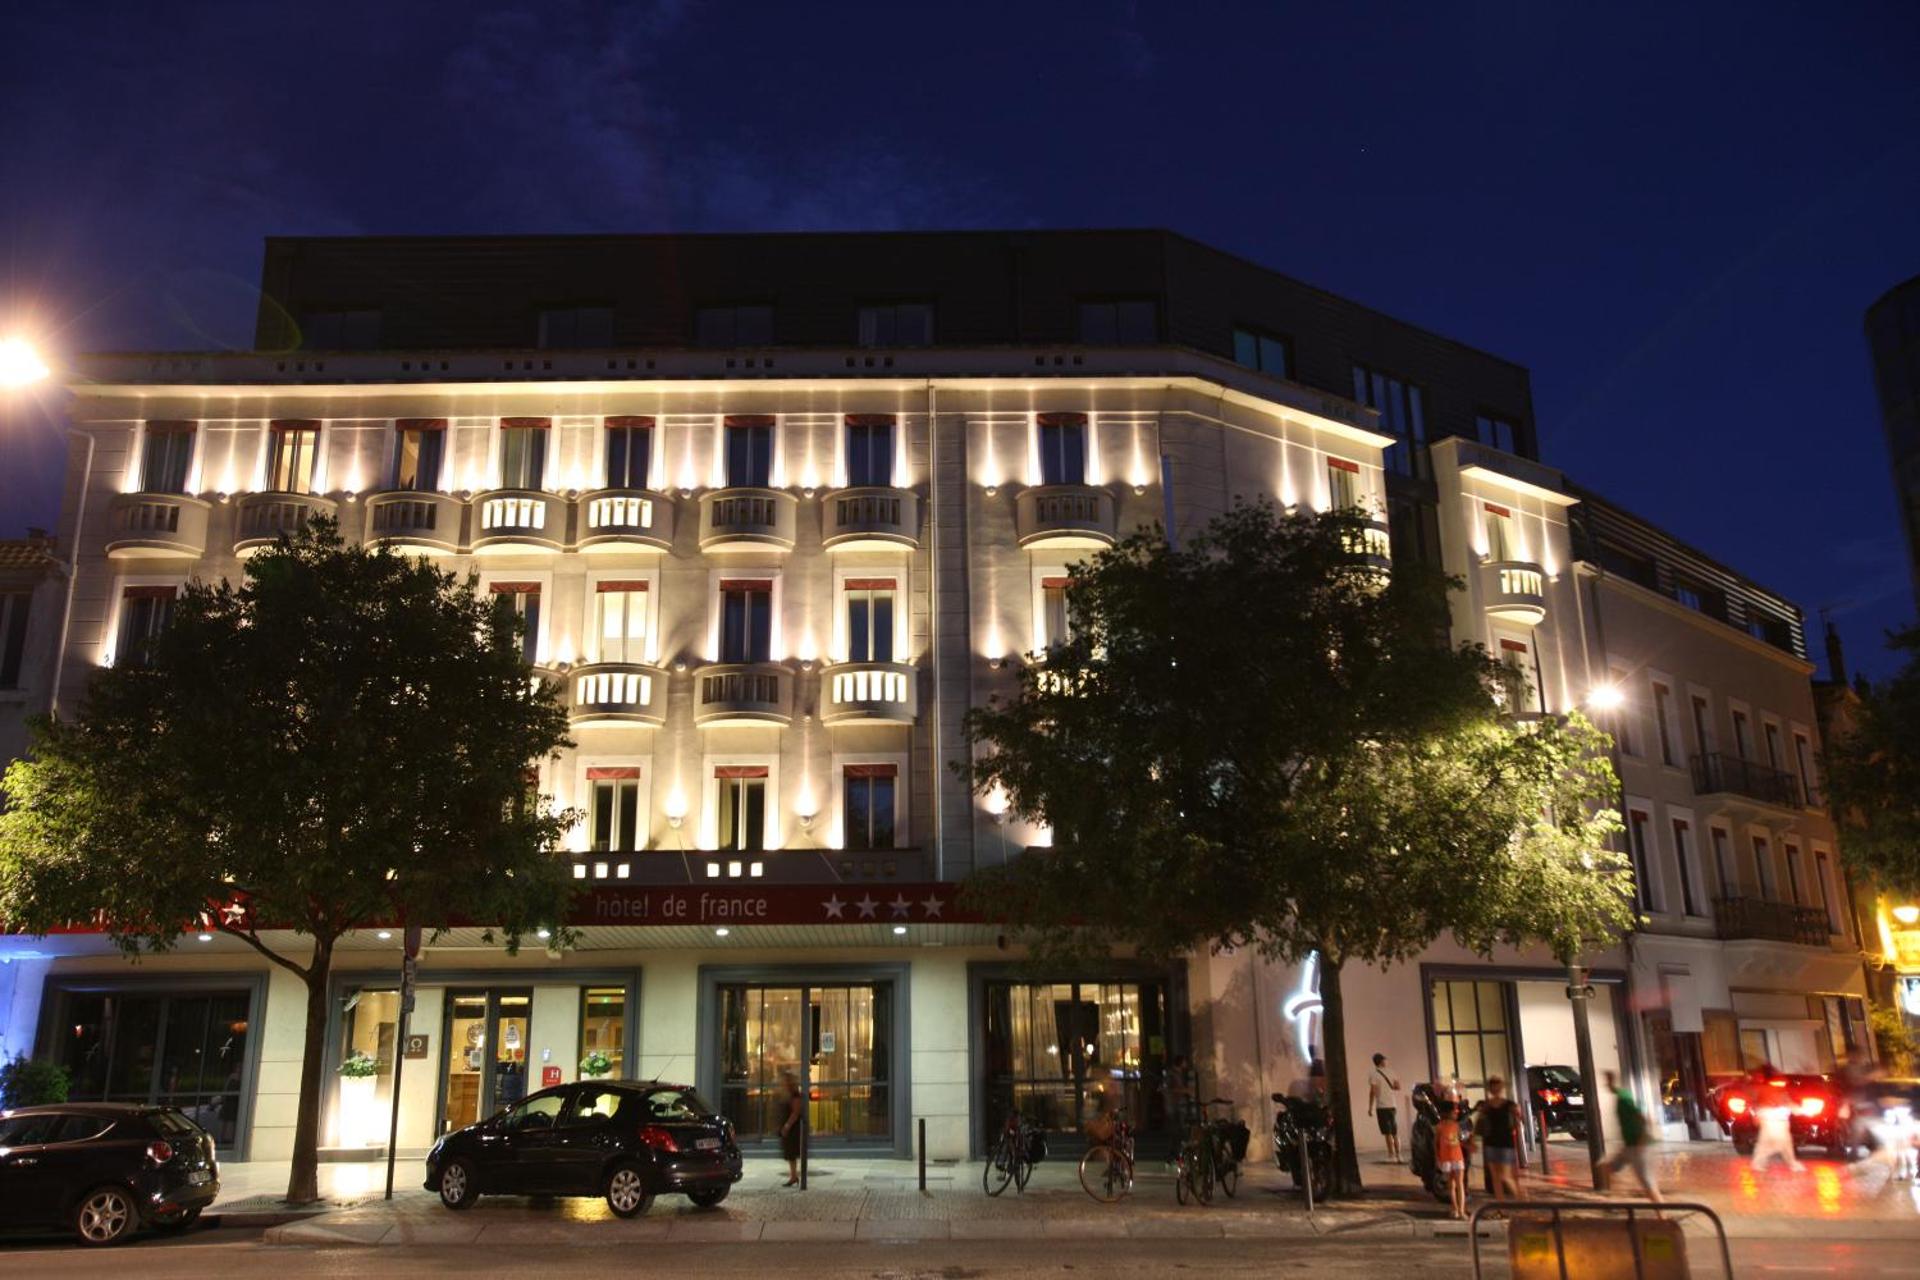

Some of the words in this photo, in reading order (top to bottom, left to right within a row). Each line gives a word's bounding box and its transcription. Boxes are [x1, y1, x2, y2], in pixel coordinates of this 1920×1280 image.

[596, 892, 649, 917] hôtel
[662, 893, 687, 917] de
[700, 892, 767, 921] france
[551, 1069, 559, 1078] H
